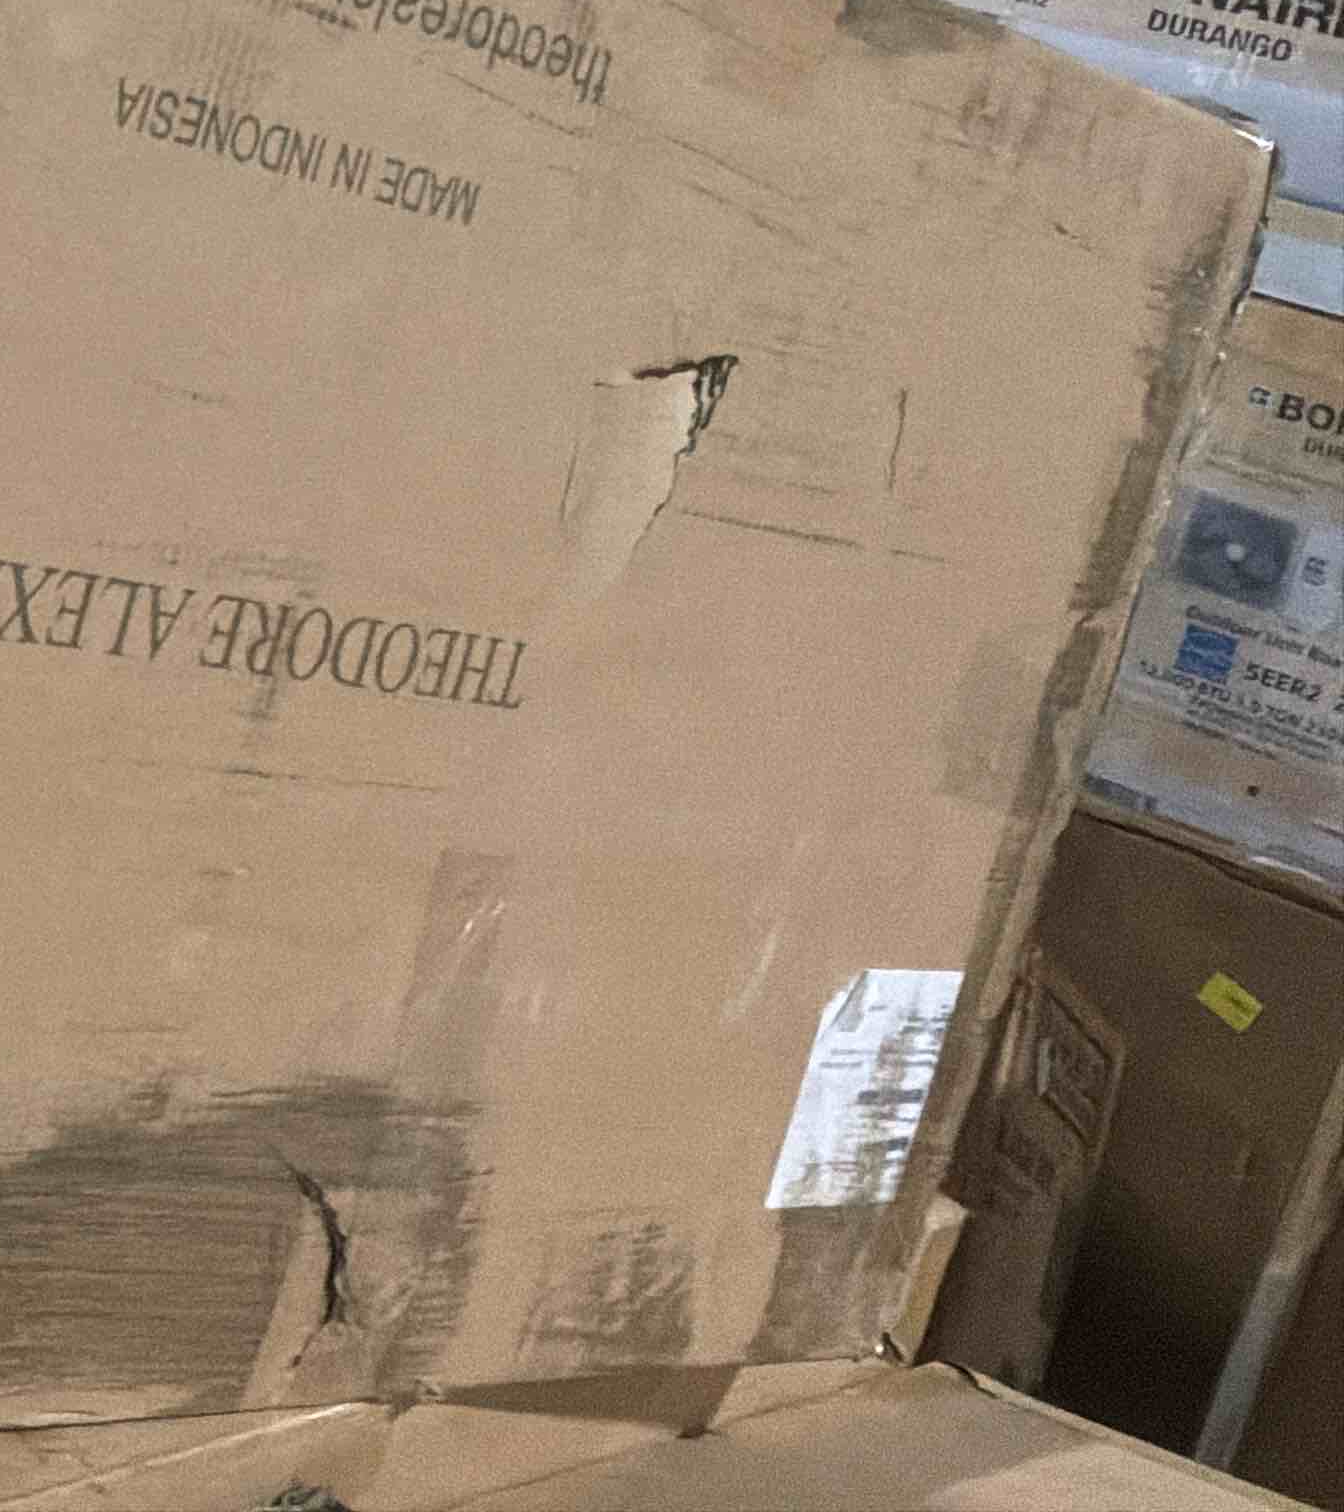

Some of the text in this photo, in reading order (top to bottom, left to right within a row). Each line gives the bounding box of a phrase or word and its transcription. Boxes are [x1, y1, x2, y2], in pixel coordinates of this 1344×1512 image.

[1147, 9, 1292, 61] DURANGO
[117, 76, 480, 227] MADE IN INDONESIA
[199, 593, 528, 710] THEODORE
